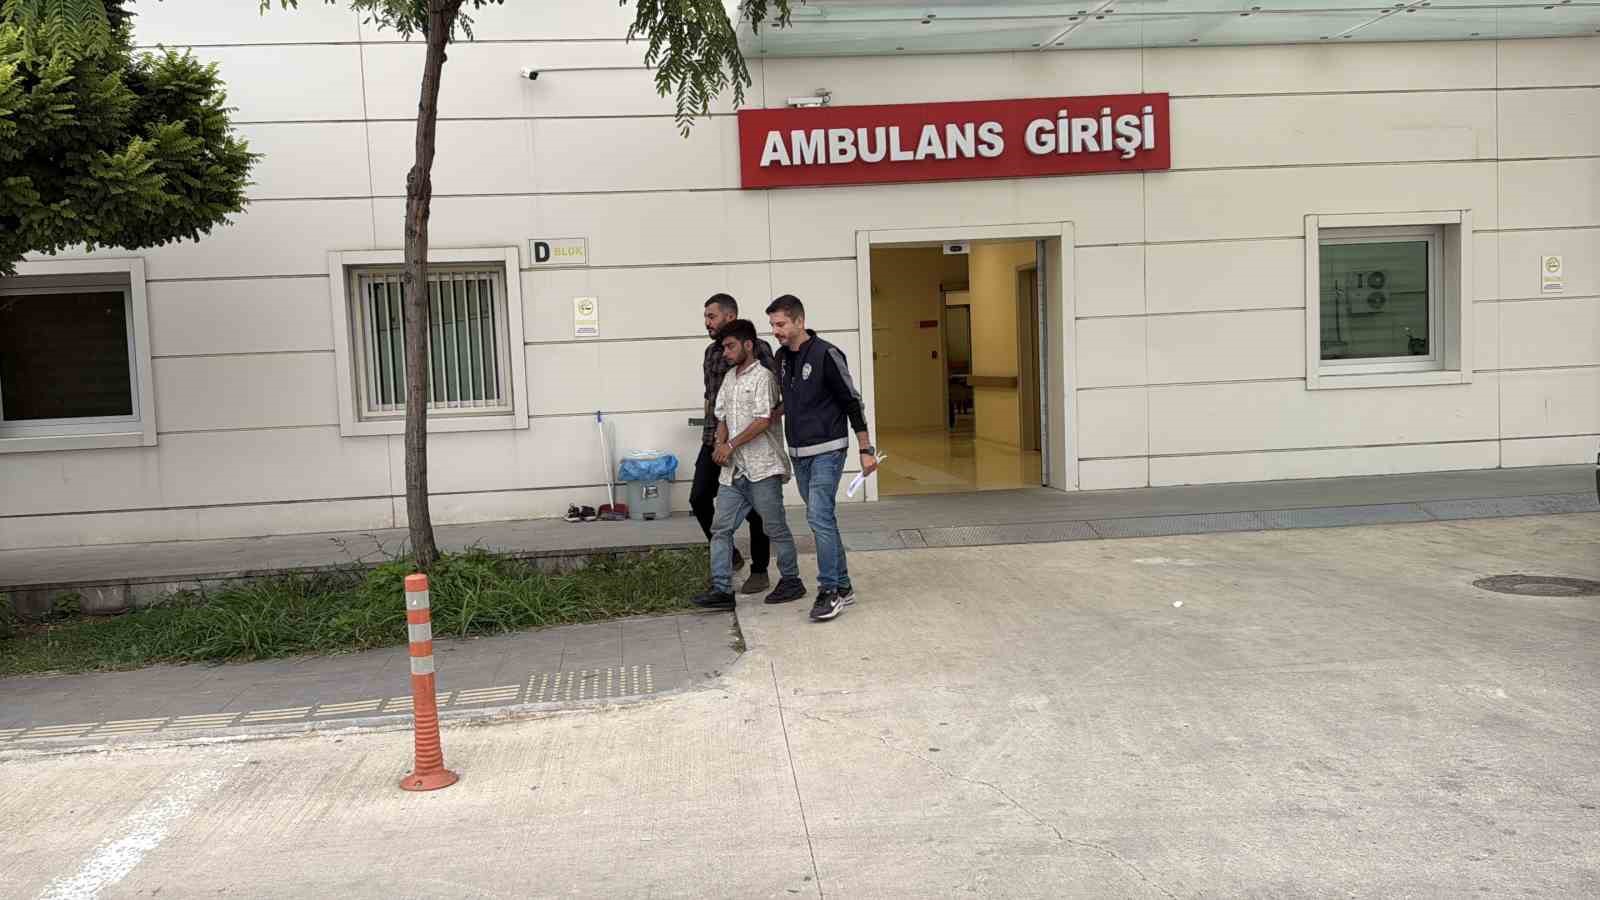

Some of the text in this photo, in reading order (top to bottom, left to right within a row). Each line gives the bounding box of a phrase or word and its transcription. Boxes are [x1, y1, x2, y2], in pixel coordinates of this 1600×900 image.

[760, 105, 1156, 167] AMBULANS GİRİŞİ
[534, 241, 550, 263] D
